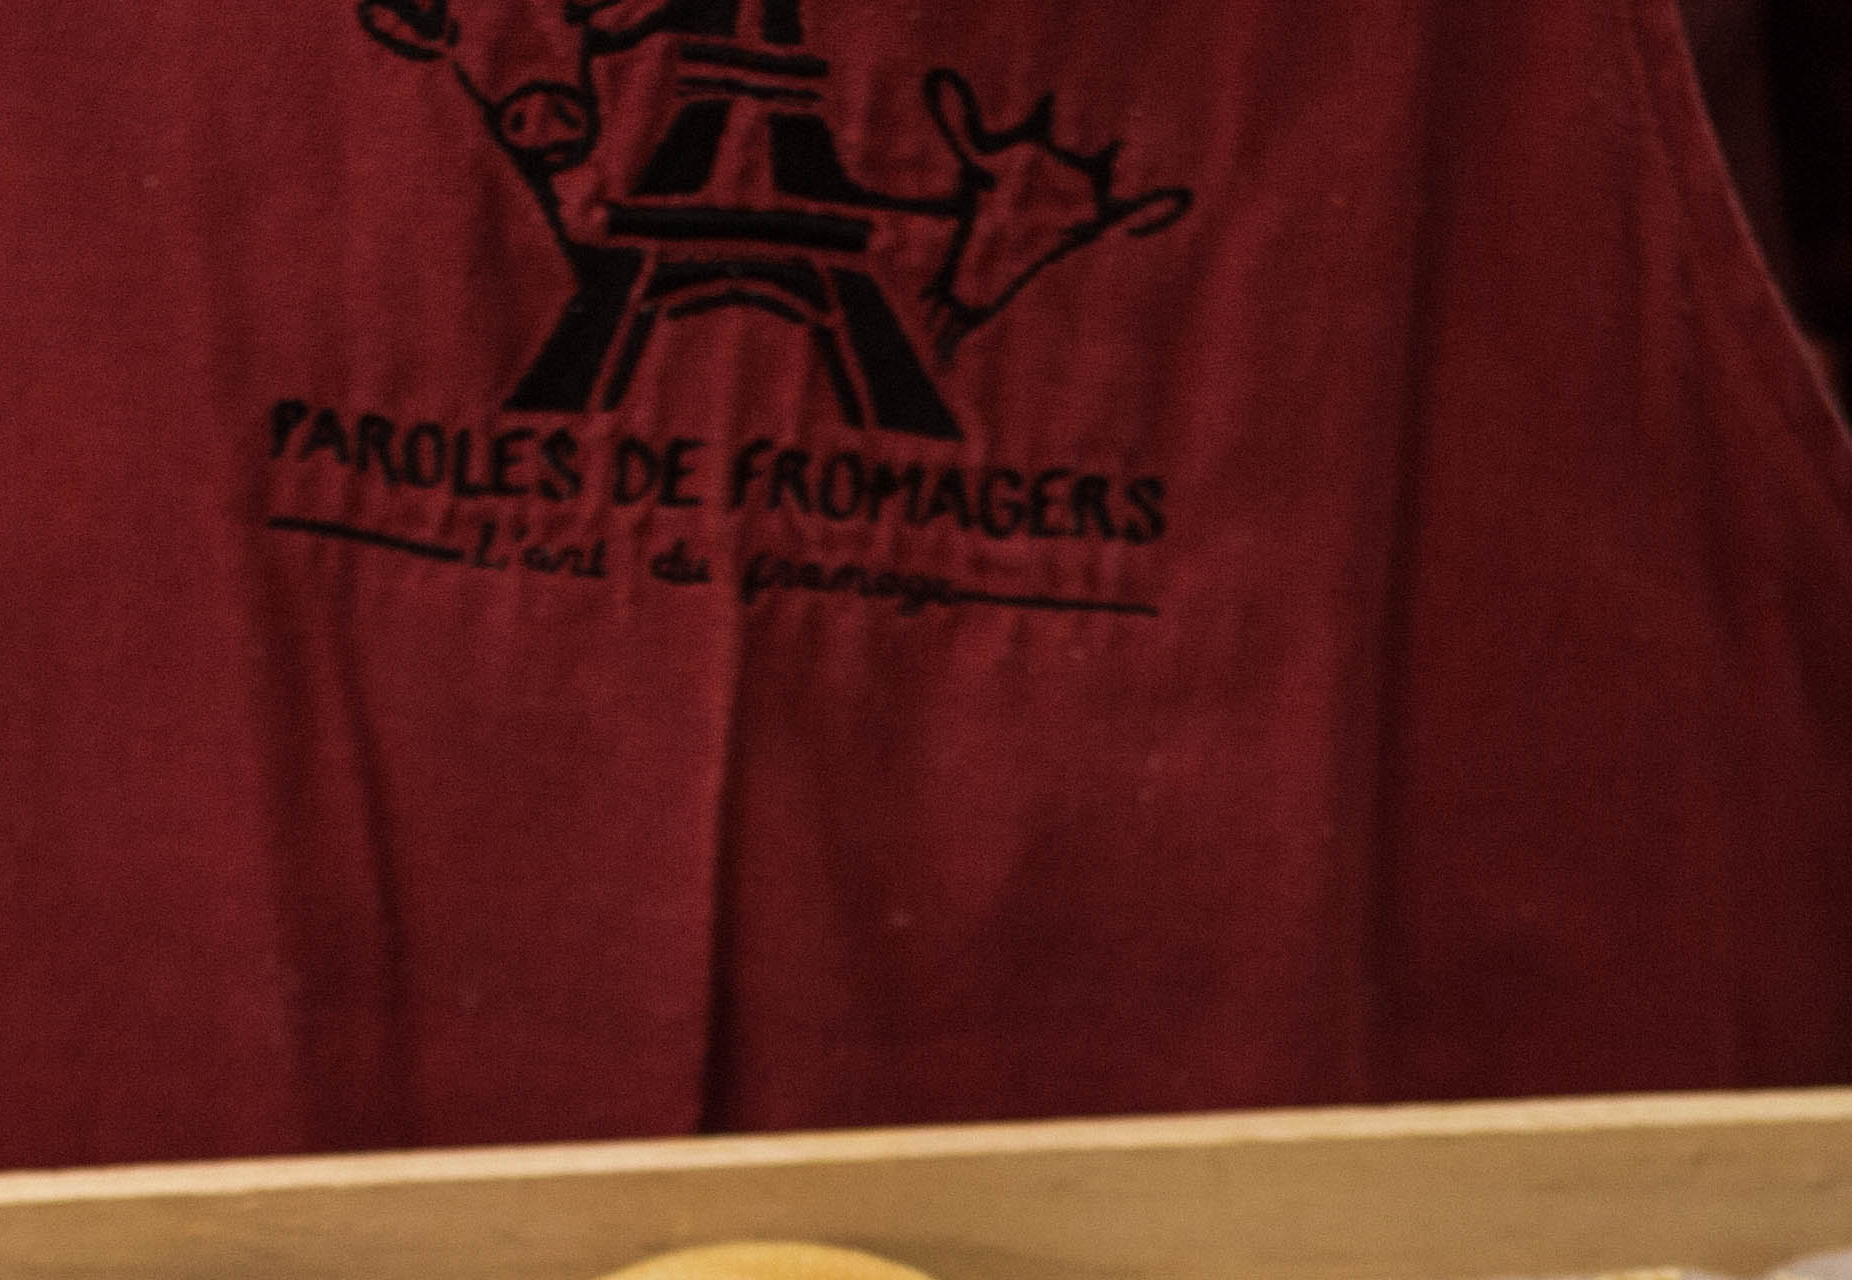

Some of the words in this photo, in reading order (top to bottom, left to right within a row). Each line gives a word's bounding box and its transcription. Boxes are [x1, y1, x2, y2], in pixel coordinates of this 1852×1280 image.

[269, 400, 581, 502] PAROLES
[614, 438, 698, 509] DE
[732, 438, 1165, 545] FROMAGERS
[651, 540, 711, 585] du
